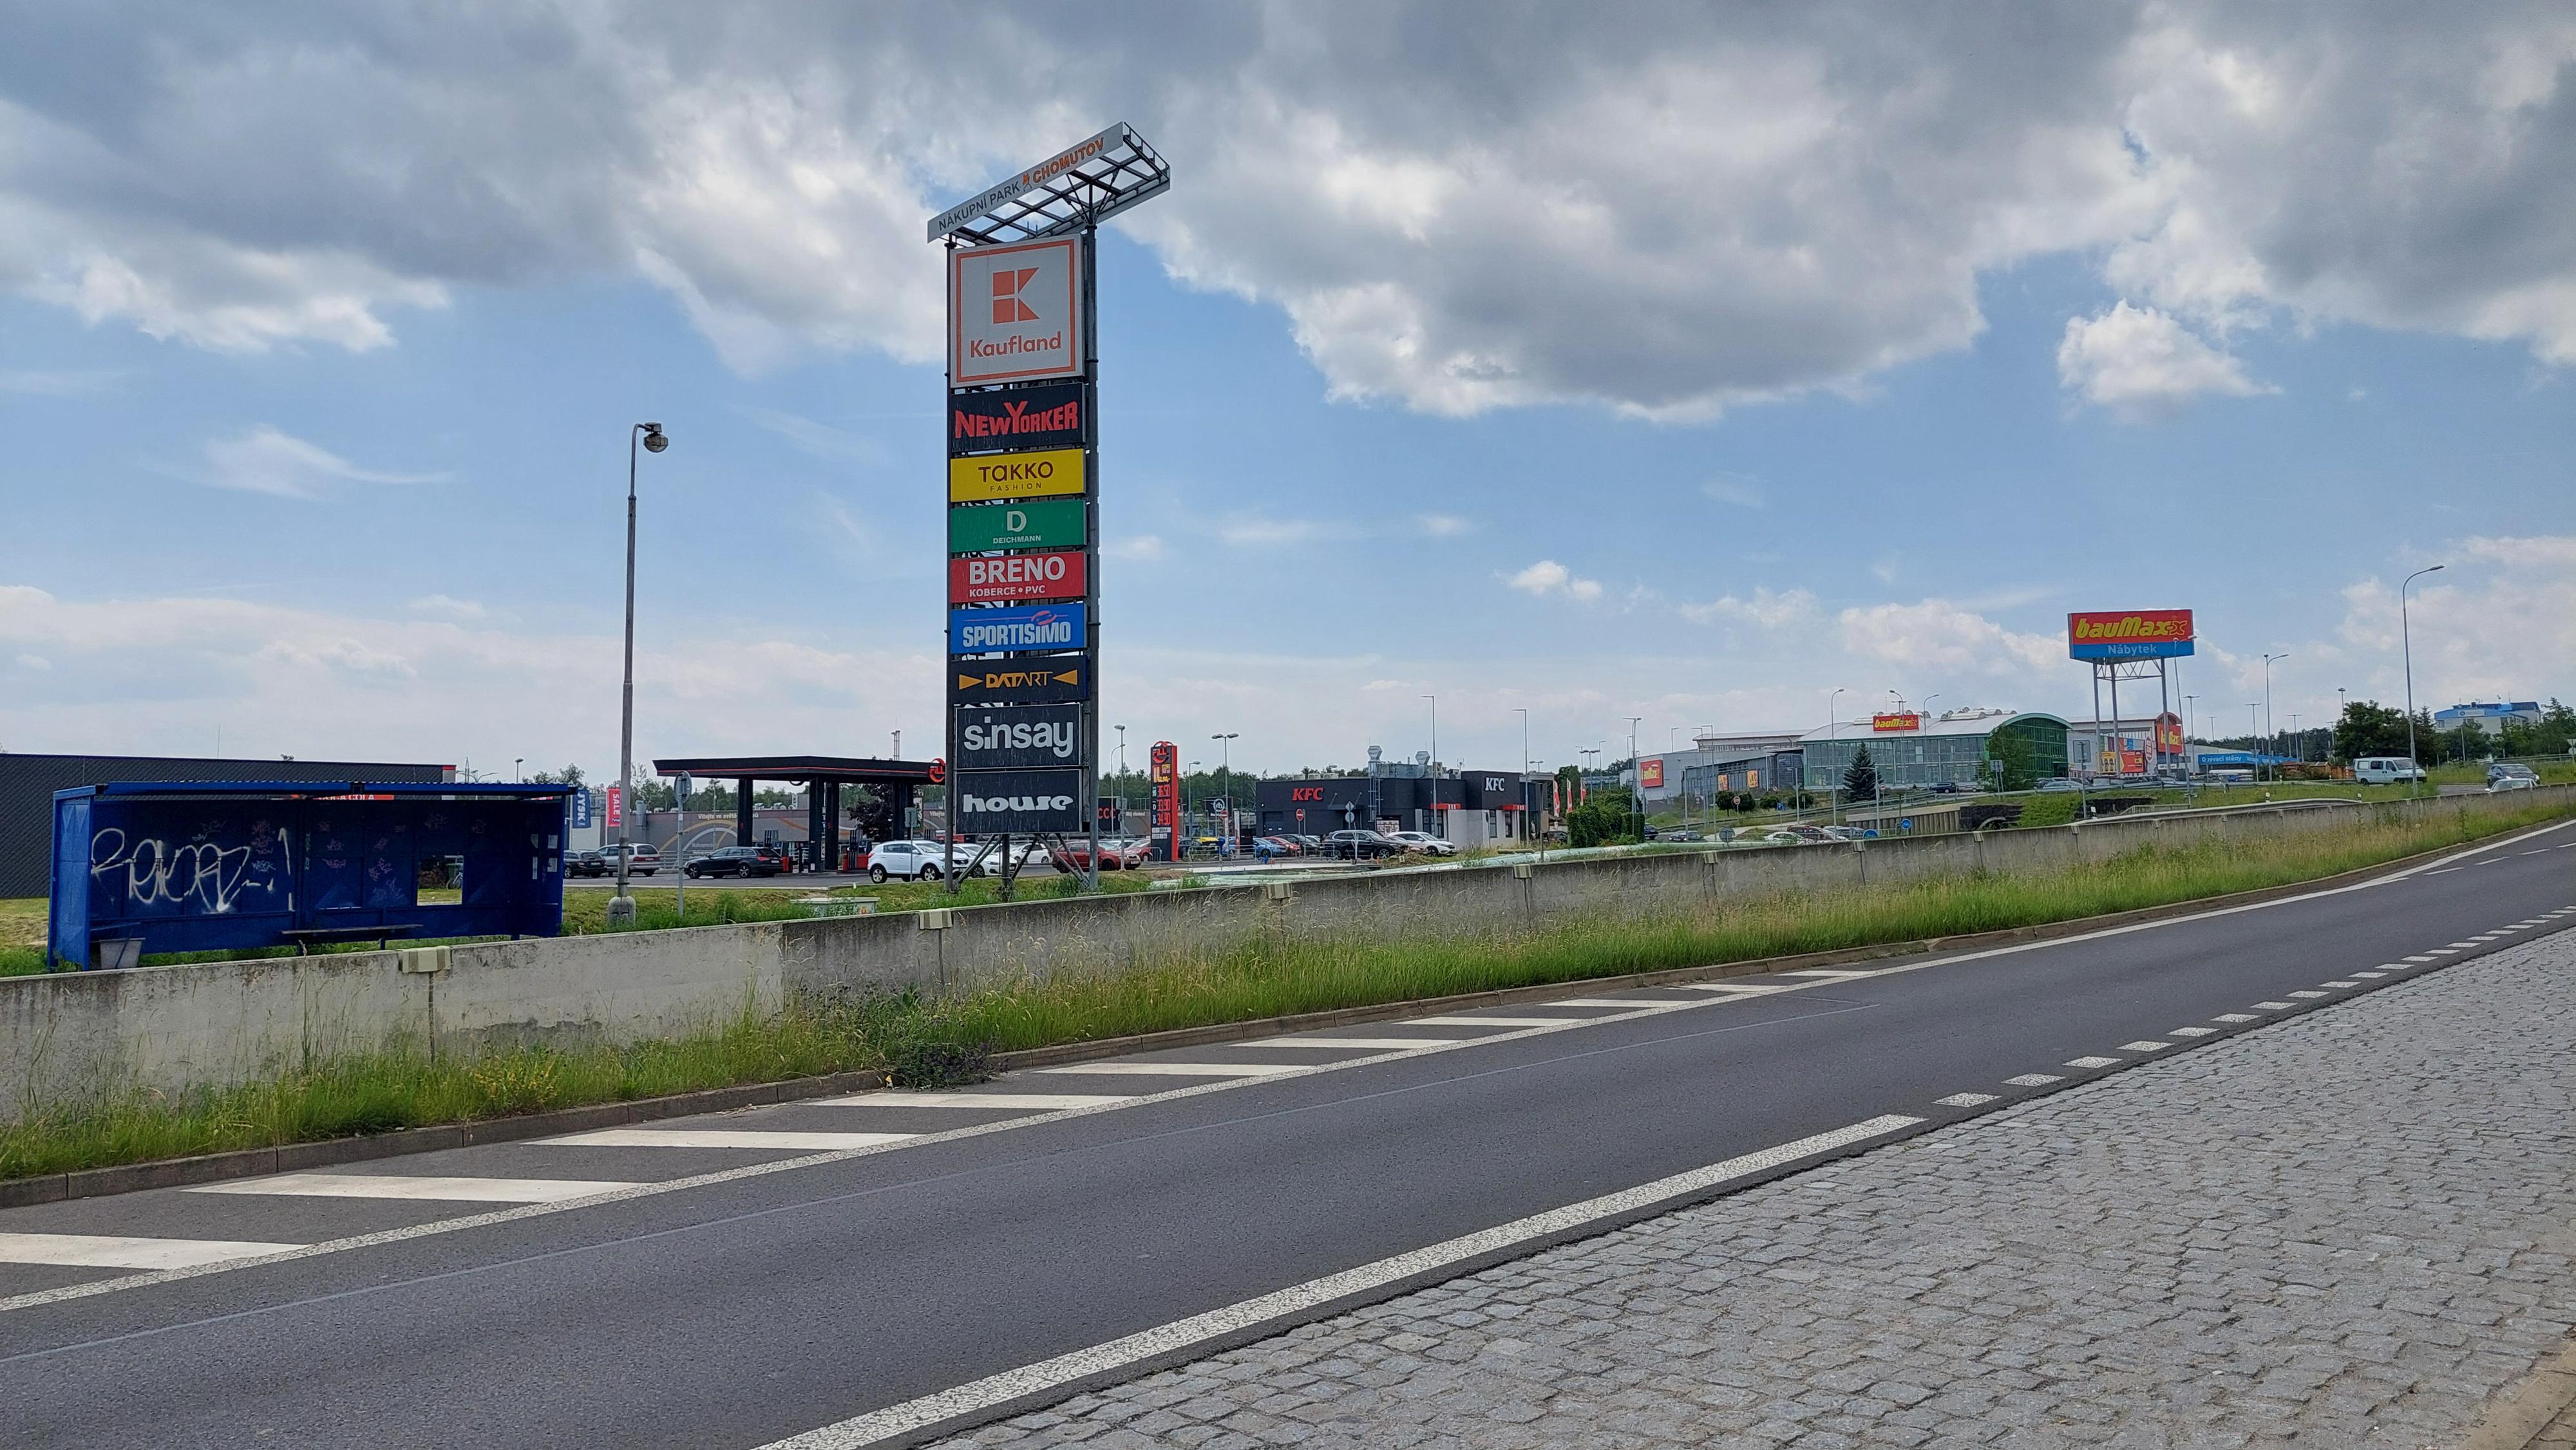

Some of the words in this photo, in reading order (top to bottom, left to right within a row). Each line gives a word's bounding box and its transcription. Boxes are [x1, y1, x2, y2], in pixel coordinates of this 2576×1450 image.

[938, 196, 987, 231] NÁKUPNÍ
[990, 181, 1021, 207] PARK
[1032, 137, 1104, 184] CHOMUTOV
[971, 331, 1061, 358] Kaufland
[990, 483, 1042, 493] FASHION
[1007, 511, 1027, 532] D
[993, 535, 1041, 544] DEICHMANN
[969, 556, 1066, 585] BRENO
[969, 587, 1016, 598] KOBERCE
[1025, 585, 1046, 594] PVC
[2108, 644, 2157, 655] Nábytek
[986, 671, 1054, 689] DATART
[963, 716, 1074, 758] sinsay
[1485, 777, 1505, 791] KFC
[963, 794, 1074, 813] house
[1292, 787, 1324, 802] KFC
[577, 792, 585, 821] JYSK
